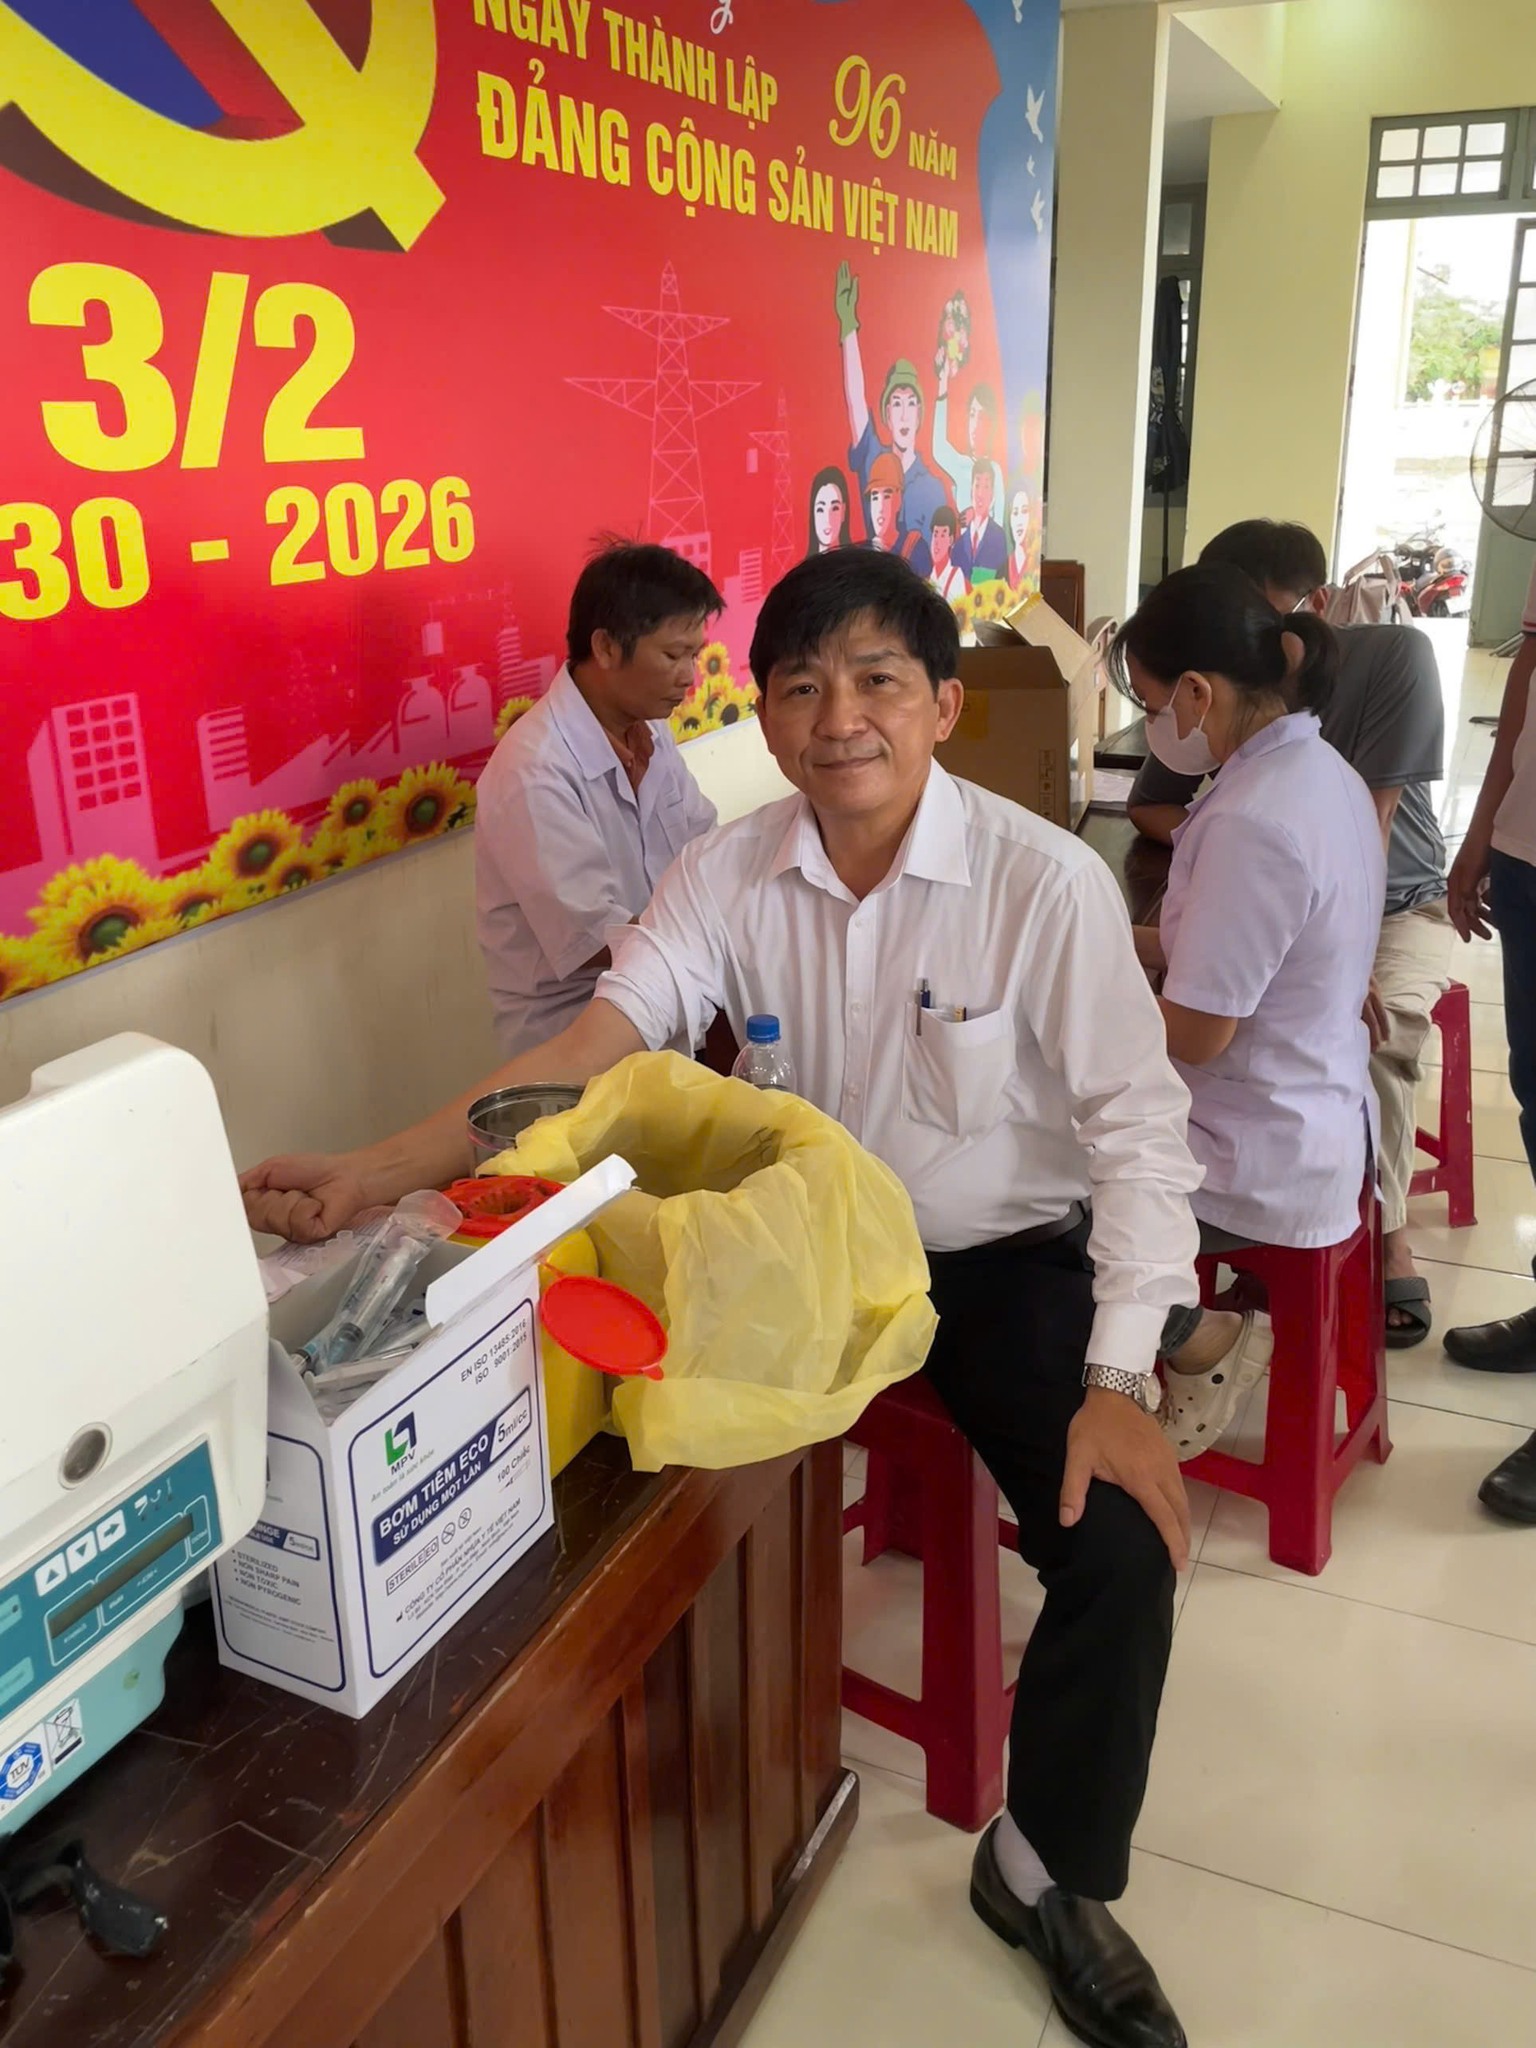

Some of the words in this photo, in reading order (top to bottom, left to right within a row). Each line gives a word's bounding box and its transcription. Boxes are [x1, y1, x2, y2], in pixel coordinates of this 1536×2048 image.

[602, 7, 717, 105] THÀNH
[725, 55, 778, 131] LẬP
[828, 55, 906, 159] 96
[908, 129, 957, 181] NĂM
[476, 58, 631, 188] ĐẢNG
[646, 117, 757, 217] CỘNG
[768, 145, 834, 233] SẢN
[843, 177, 899, 256] VIỆT
[905, 198, 958, 259] NAM
[28, 261, 366, 472] 3/2
[265, 475, 476, 587] 2026
[460, 1366, 473, 1382] EN
[473, 1353, 488, 1371] ISO
[475, 1367, 489, 1385] ISO
[379, 1494, 419, 1539] BƠM
[421, 1461, 457, 1502] TIÊM
[459, 1434, 489, 1472] ECO
[390, 1448, 416, 1476] MPV
[497, 1464, 511, 1483] 100
[411, 1499, 440, 1532] DỤNG
[388, 1553, 426, 1591] STERILE
